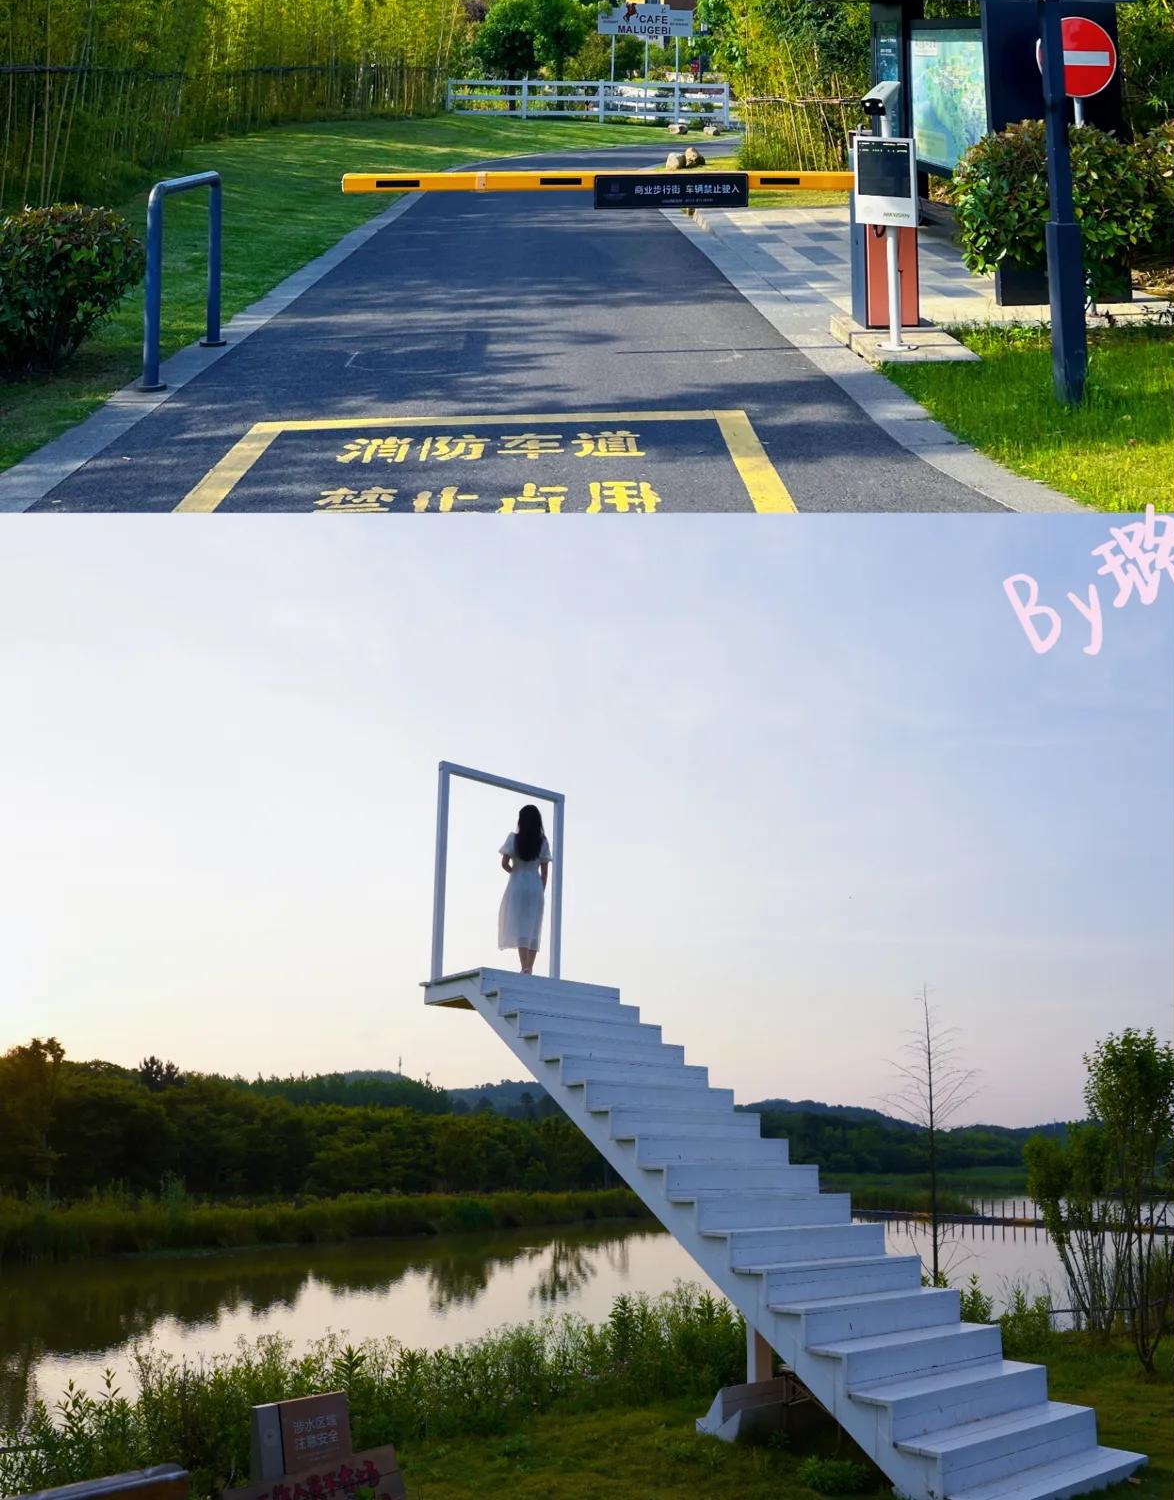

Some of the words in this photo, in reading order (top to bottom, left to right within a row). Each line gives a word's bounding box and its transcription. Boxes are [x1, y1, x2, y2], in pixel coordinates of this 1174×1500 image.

[639, 14, 669, 24] CAFE
[617, 25, 671, 35] MALUGEBI
[634, 185, 681, 195] 商业步行街
[685, 183, 740, 194] 车辆禁止驶入
[336, 430, 646, 464] 消防车道
